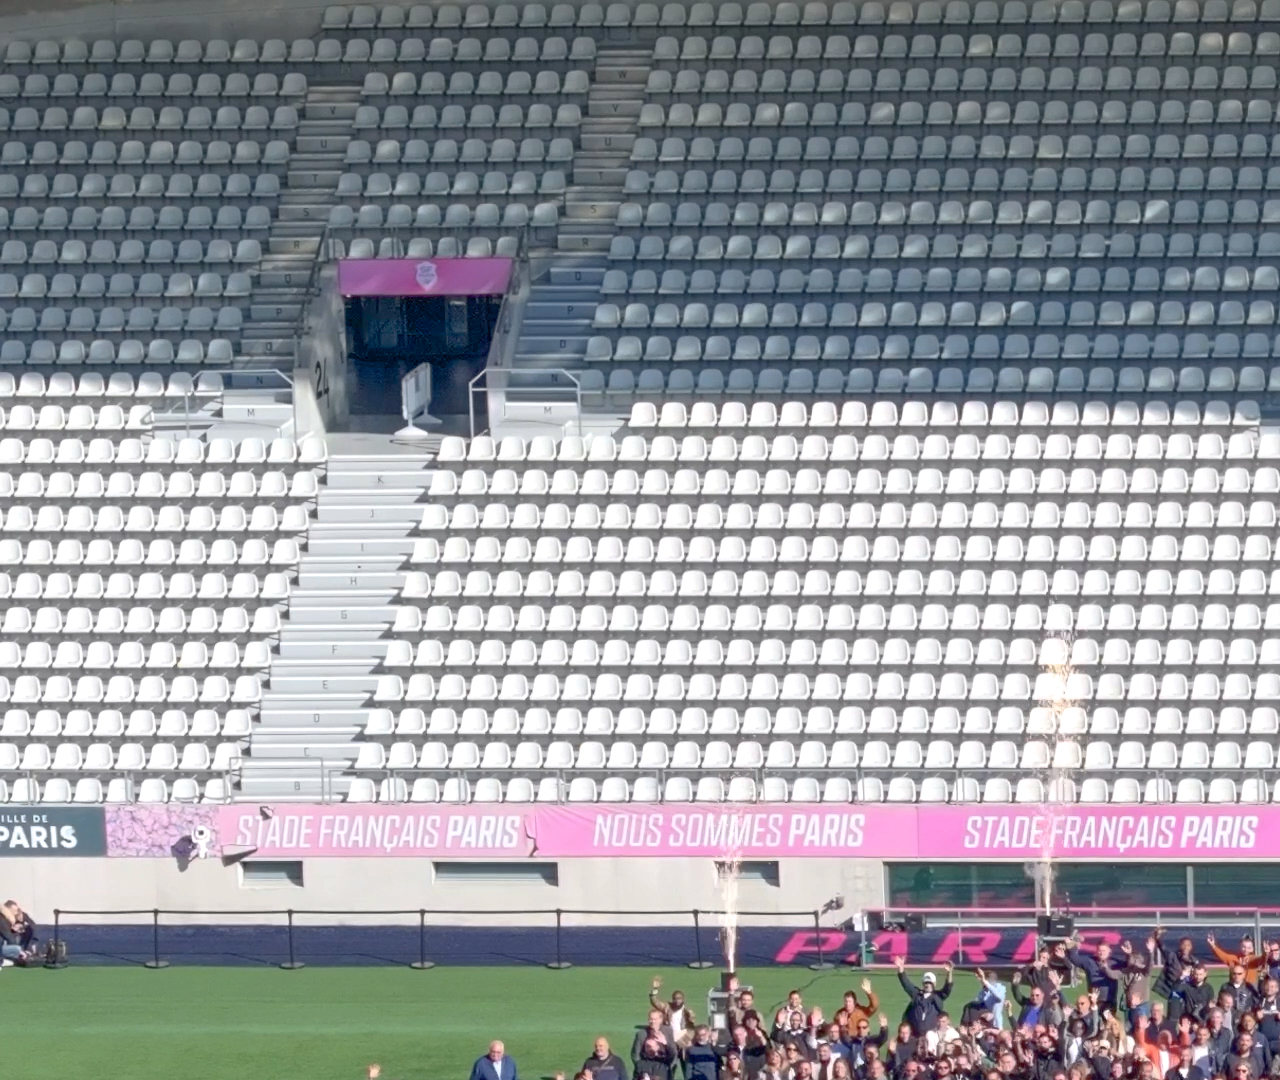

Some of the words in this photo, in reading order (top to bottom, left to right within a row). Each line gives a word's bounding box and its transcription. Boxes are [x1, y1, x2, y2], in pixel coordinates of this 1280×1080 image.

[314, 356, 331, 409] 24
[33, 814, 48, 823] DE
[237, 815, 314, 848] STADE
[318, 815, 441, 852] FRANÇAIS
[445, 815, 521, 848] PARIS
[593, 813, 663, 847] NOUS
[668, 813, 784, 847] SOMMES
[787, 814, 865, 847] PARIS
[964, 816, 1045, 849] STADE
[1048, 816, 1176, 853] FRANÇAIS
[1179, 816, 1259, 849] PARIS
